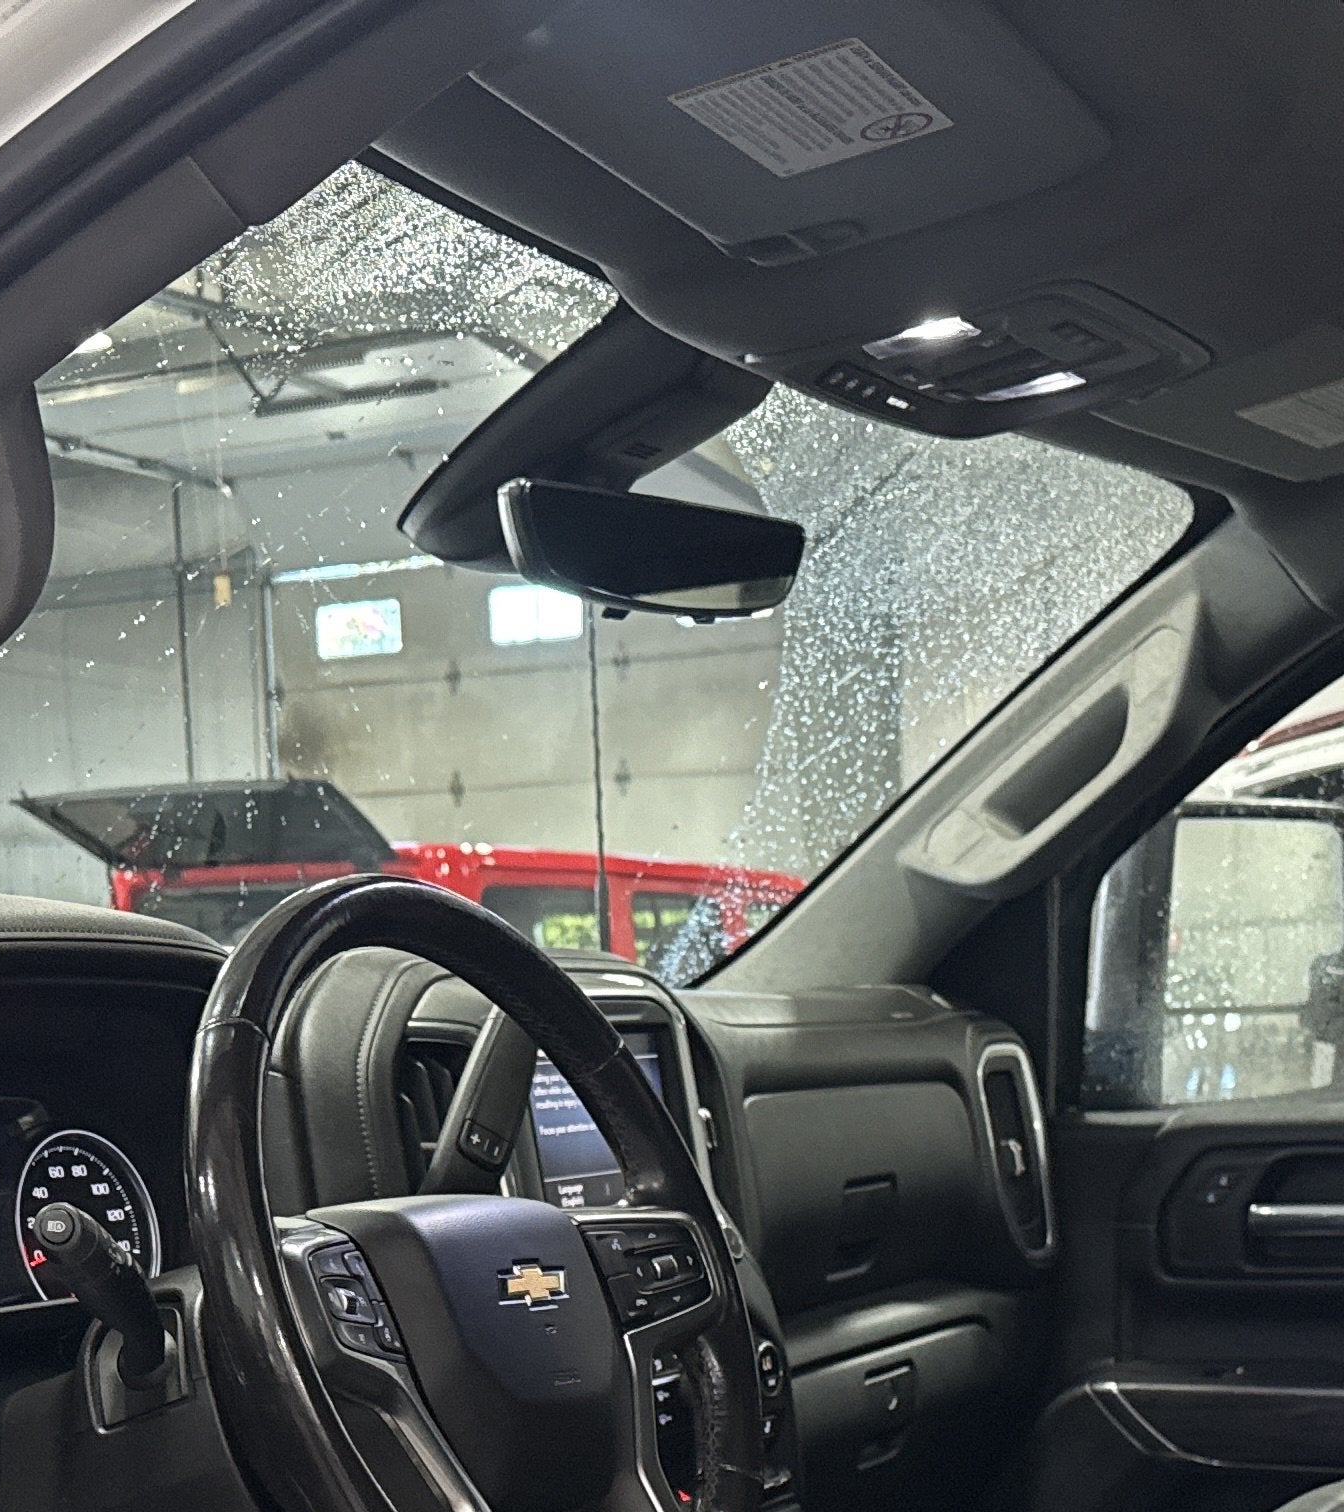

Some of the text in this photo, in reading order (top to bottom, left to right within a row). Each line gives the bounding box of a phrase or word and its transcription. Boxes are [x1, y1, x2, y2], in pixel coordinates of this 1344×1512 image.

[48, 1166, 64, 1178] 60
[71, 1165, 87, 1177] 80
[32, 1187, 48, 1199] 40
[91, 1183, 110, 1195] 100
[106, 1208, 125, 1221] 120
